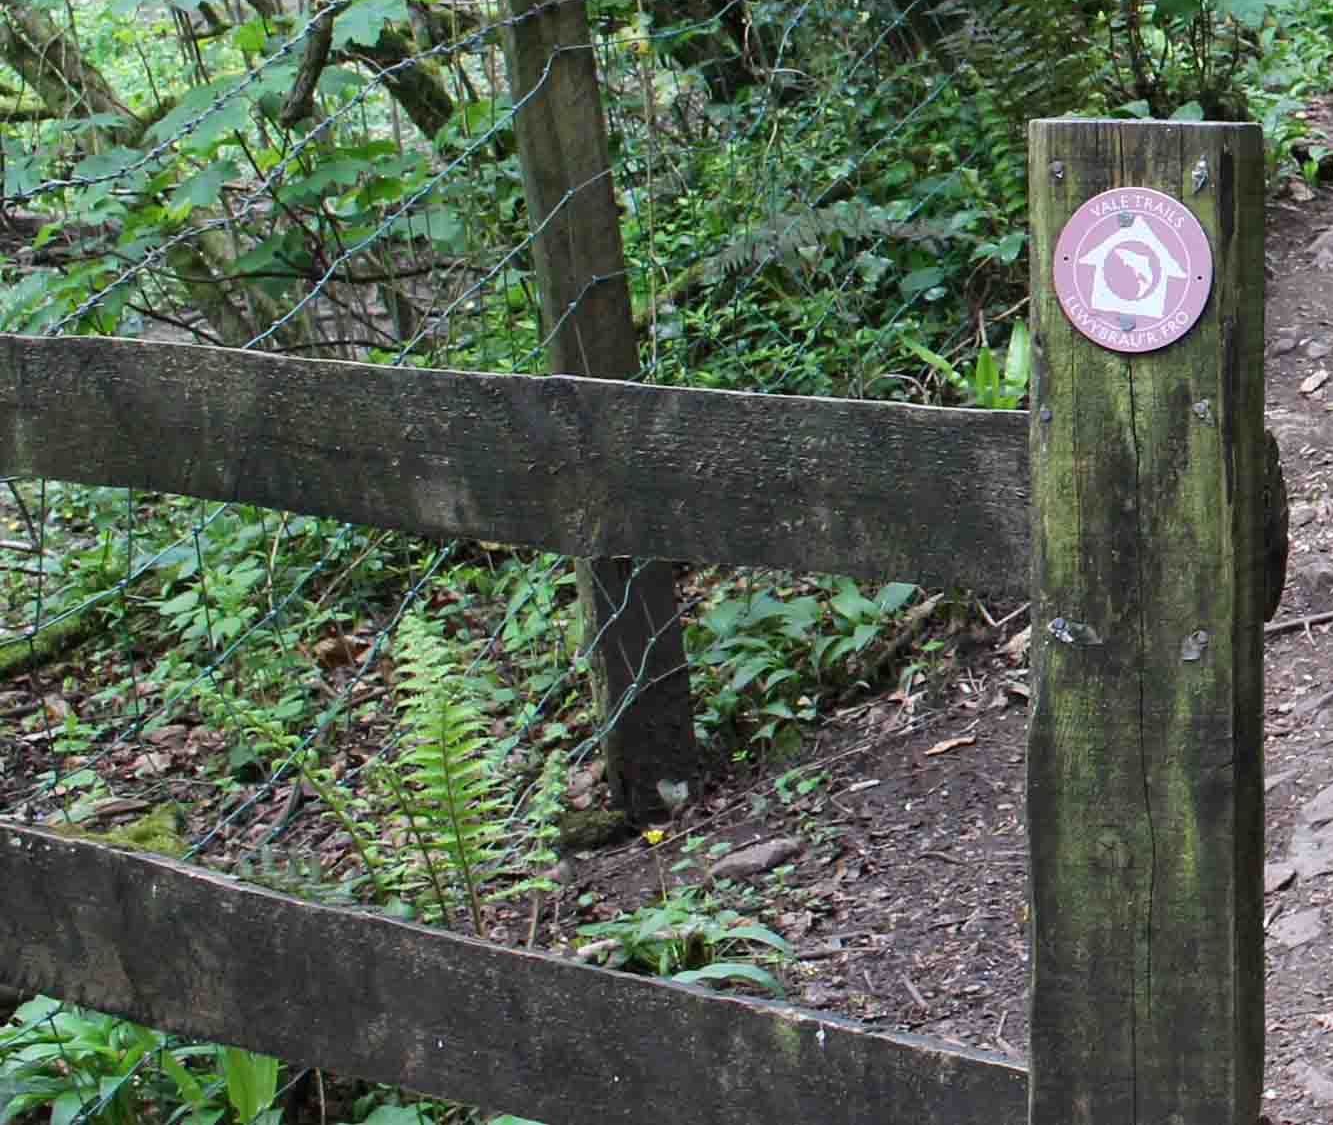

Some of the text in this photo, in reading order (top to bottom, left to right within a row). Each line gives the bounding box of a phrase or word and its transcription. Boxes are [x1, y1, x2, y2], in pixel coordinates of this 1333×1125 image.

[1090, 195, 1186, 228] VALE TRAILS
[1065, 297, 1190, 347] LLWYBRAU'R FRO
